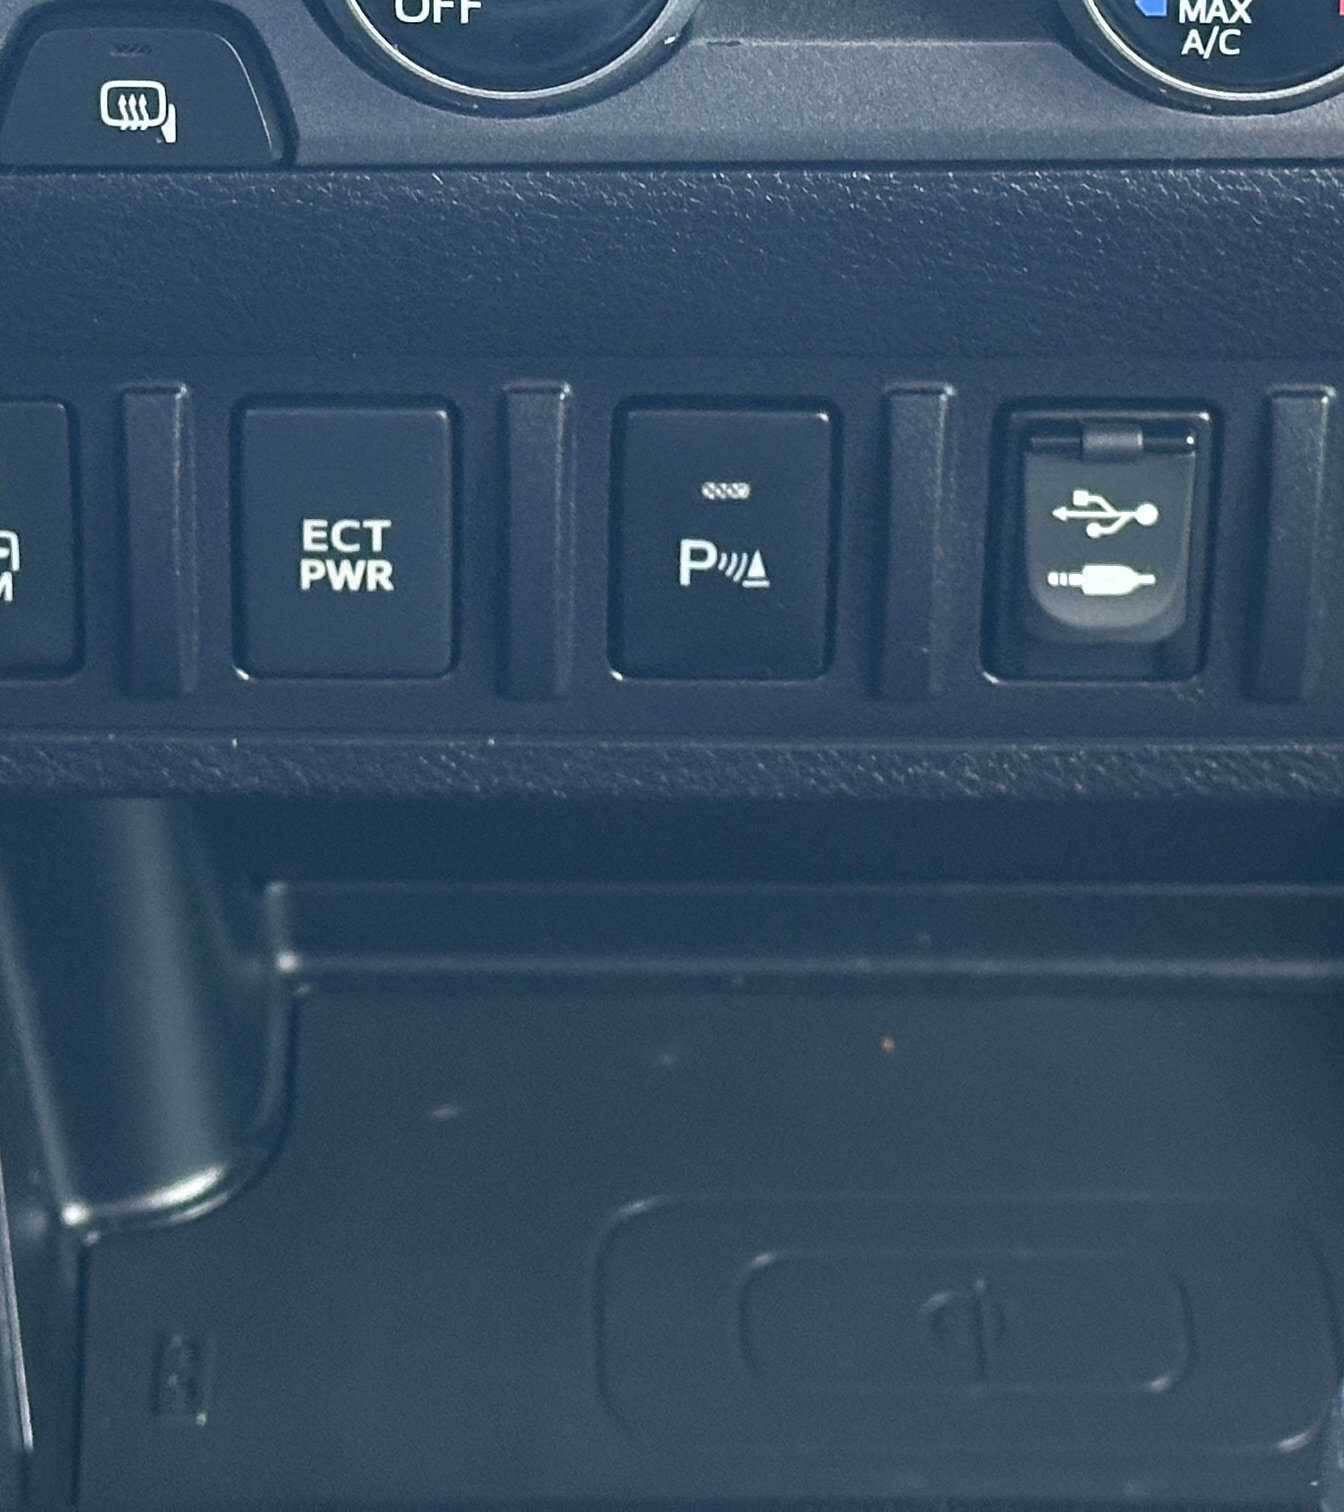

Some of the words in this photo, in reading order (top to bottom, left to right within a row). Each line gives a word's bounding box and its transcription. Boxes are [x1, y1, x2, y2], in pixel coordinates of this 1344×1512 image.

[1181, 27, 1242, 58] A/C
[302, 518, 392, 553] ECT
[300, 558, 394, 592] PWR
[679, 538, 717, 586] P
